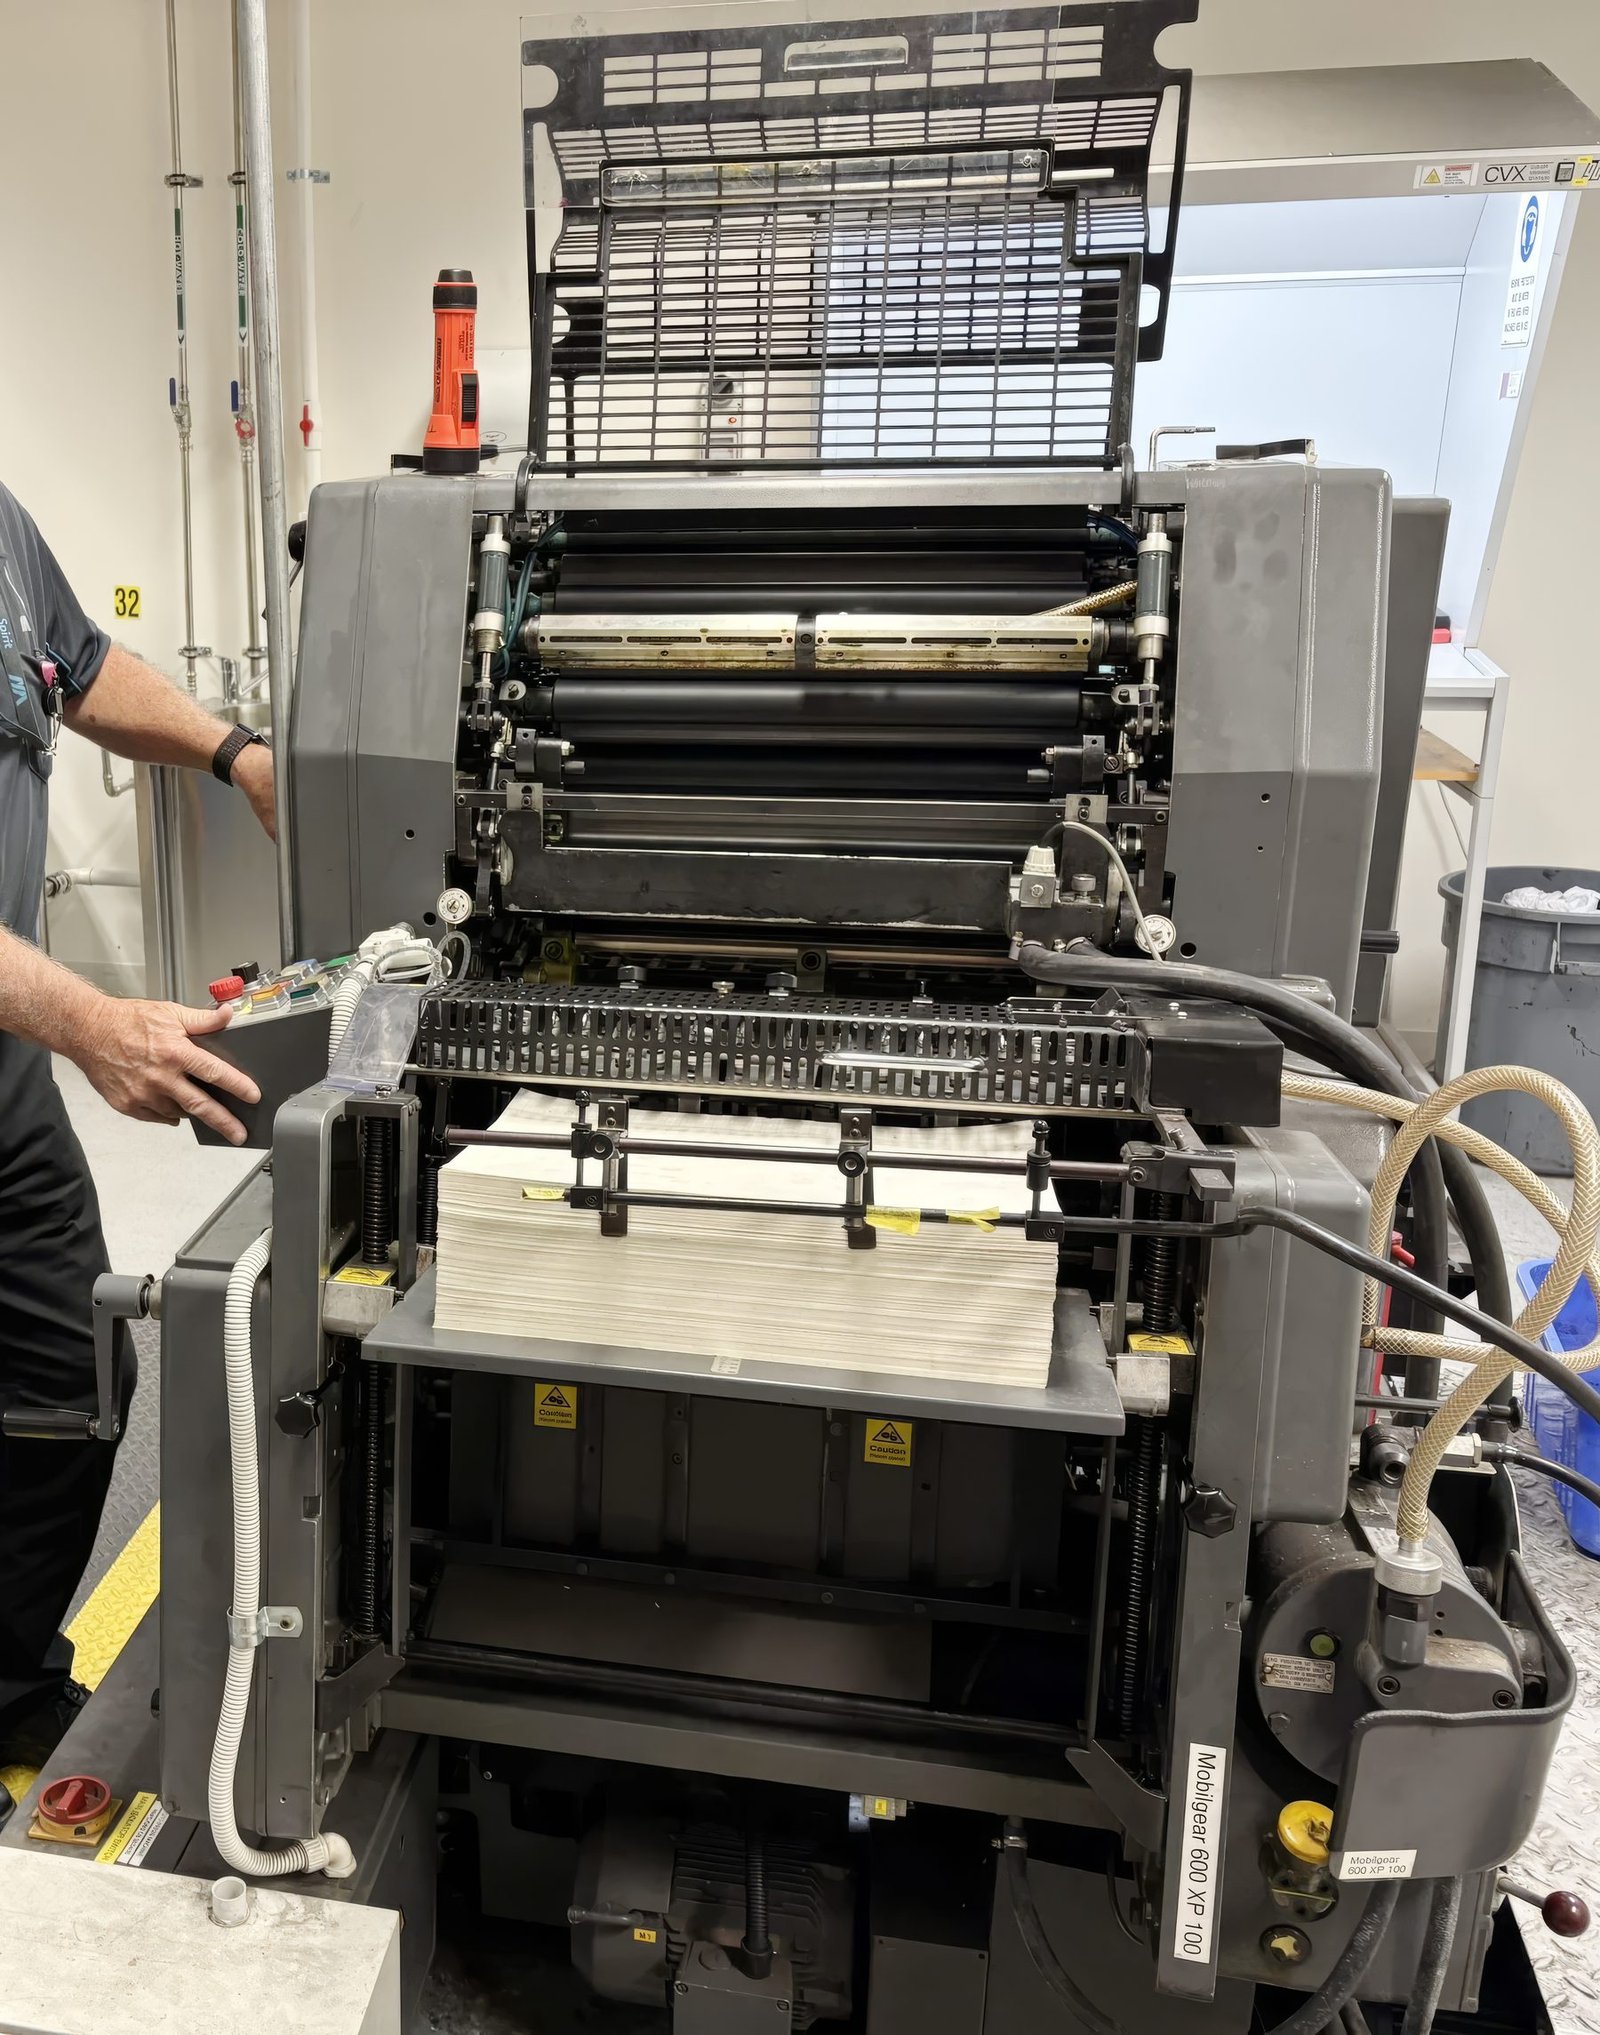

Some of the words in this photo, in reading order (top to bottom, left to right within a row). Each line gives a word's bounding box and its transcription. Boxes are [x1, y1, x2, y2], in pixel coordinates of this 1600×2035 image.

[1485, 165, 1527, 182] CVX
[114, 587, 140, 618] 32
[1191, 1751, 1217, 1844] Mobilgear
[1188, 1848, 1210, 1883] 600
[1348, 1866, 1367, 1875] 600
[1369, 1866, 1385, 1874] XP
[1388, 1865, 1406, 1873] 100
[1350, 1856, 1401, 1865] Mobilgear
[1186, 1888, 1206, 1916] XP
[1183, 1922, 1203, 1955] 100
